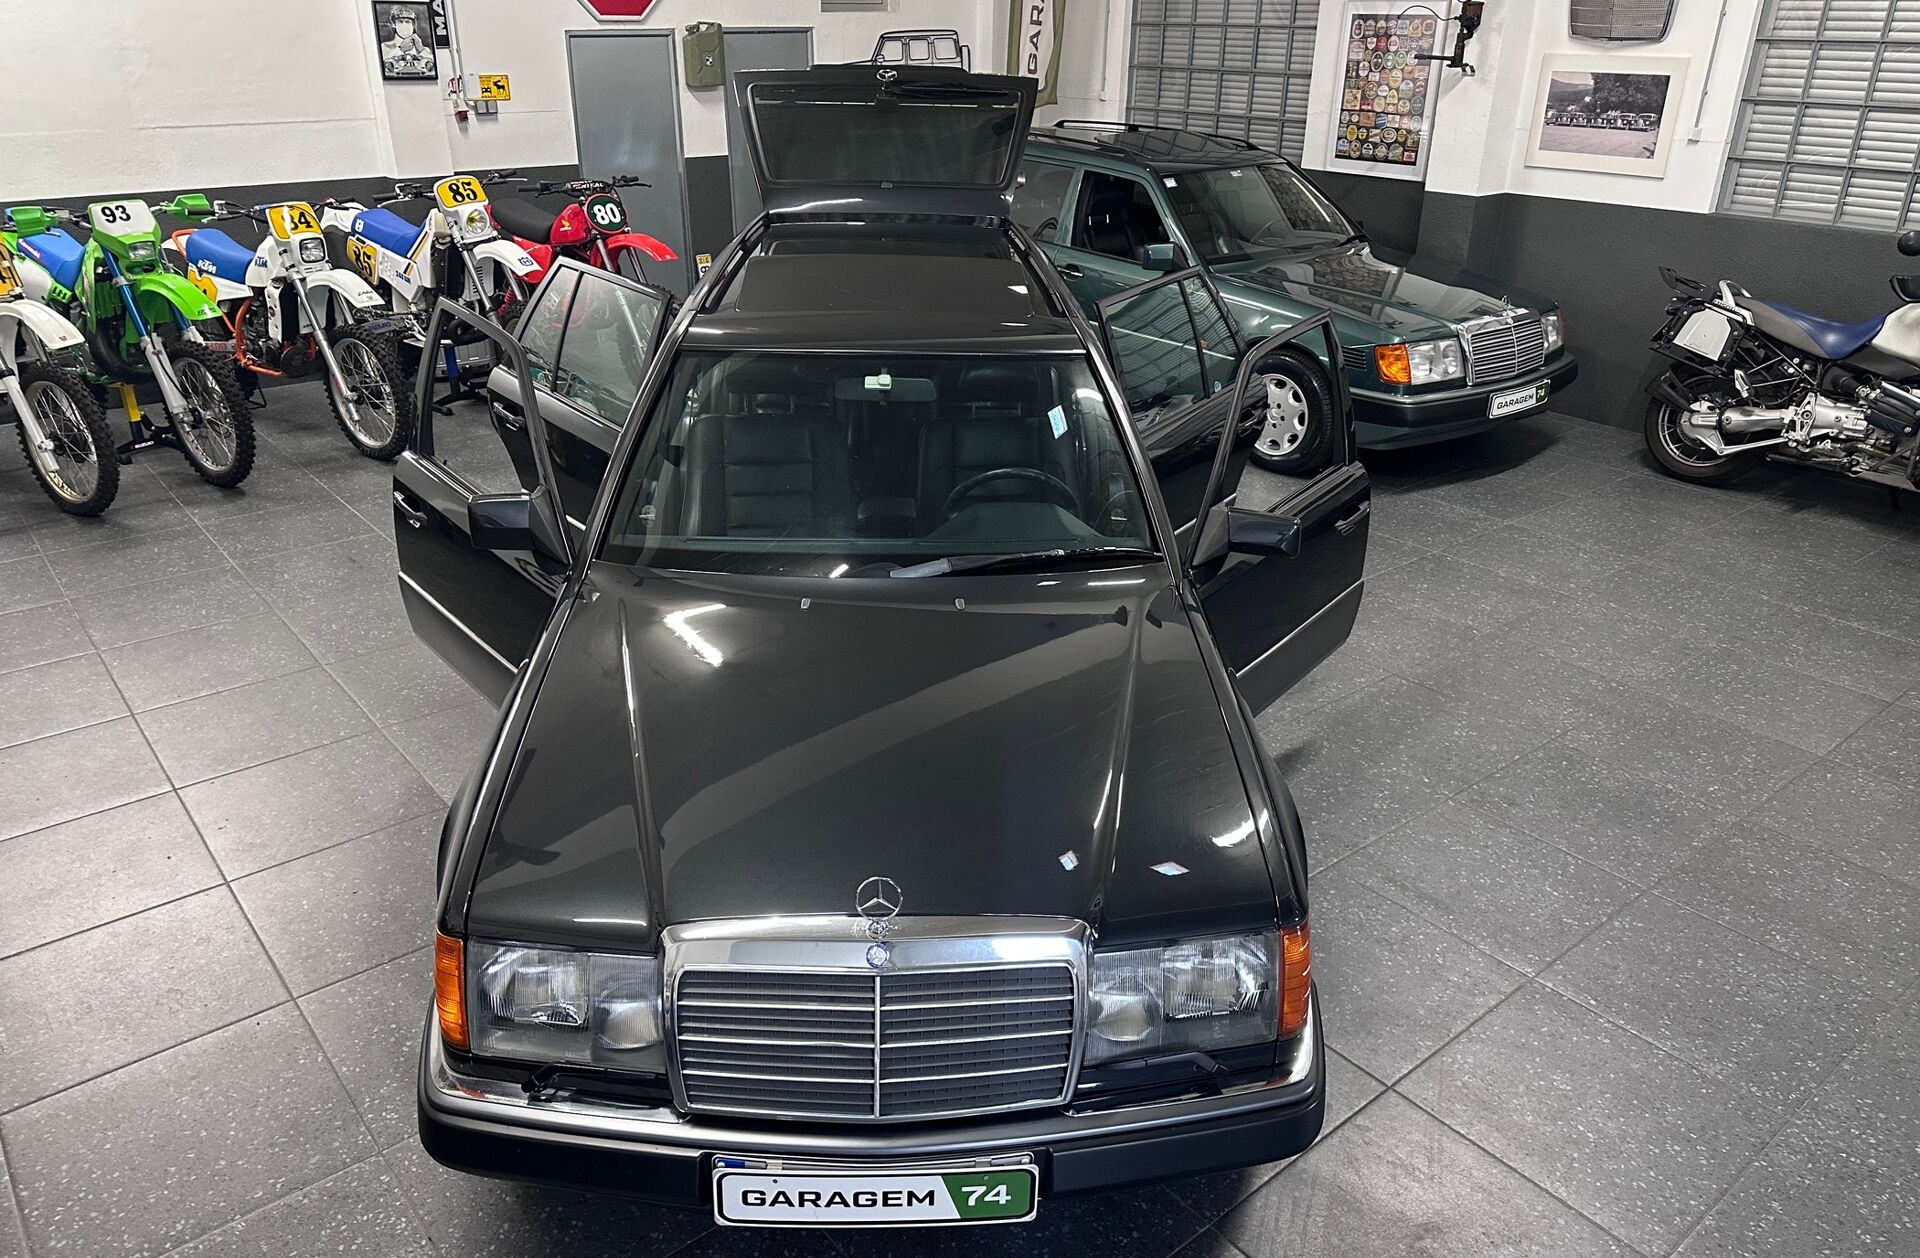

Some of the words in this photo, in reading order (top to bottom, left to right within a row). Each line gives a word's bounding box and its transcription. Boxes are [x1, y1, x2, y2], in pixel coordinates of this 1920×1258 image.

[1027, 0, 1044, 75] GAR
[448, 181, 478, 203] 85
[100, 204, 131, 223] 93
[592, 203, 622, 225] 80
[197, 259, 217, 274] KTM
[254, 256, 268, 269] KTM
[352, 245, 373, 278] 85
[1497, 393, 1534, 409] GARAGEM
[741, 1189, 935, 1208] GARAGEM
[960, 1184, 1012, 1207] 74
